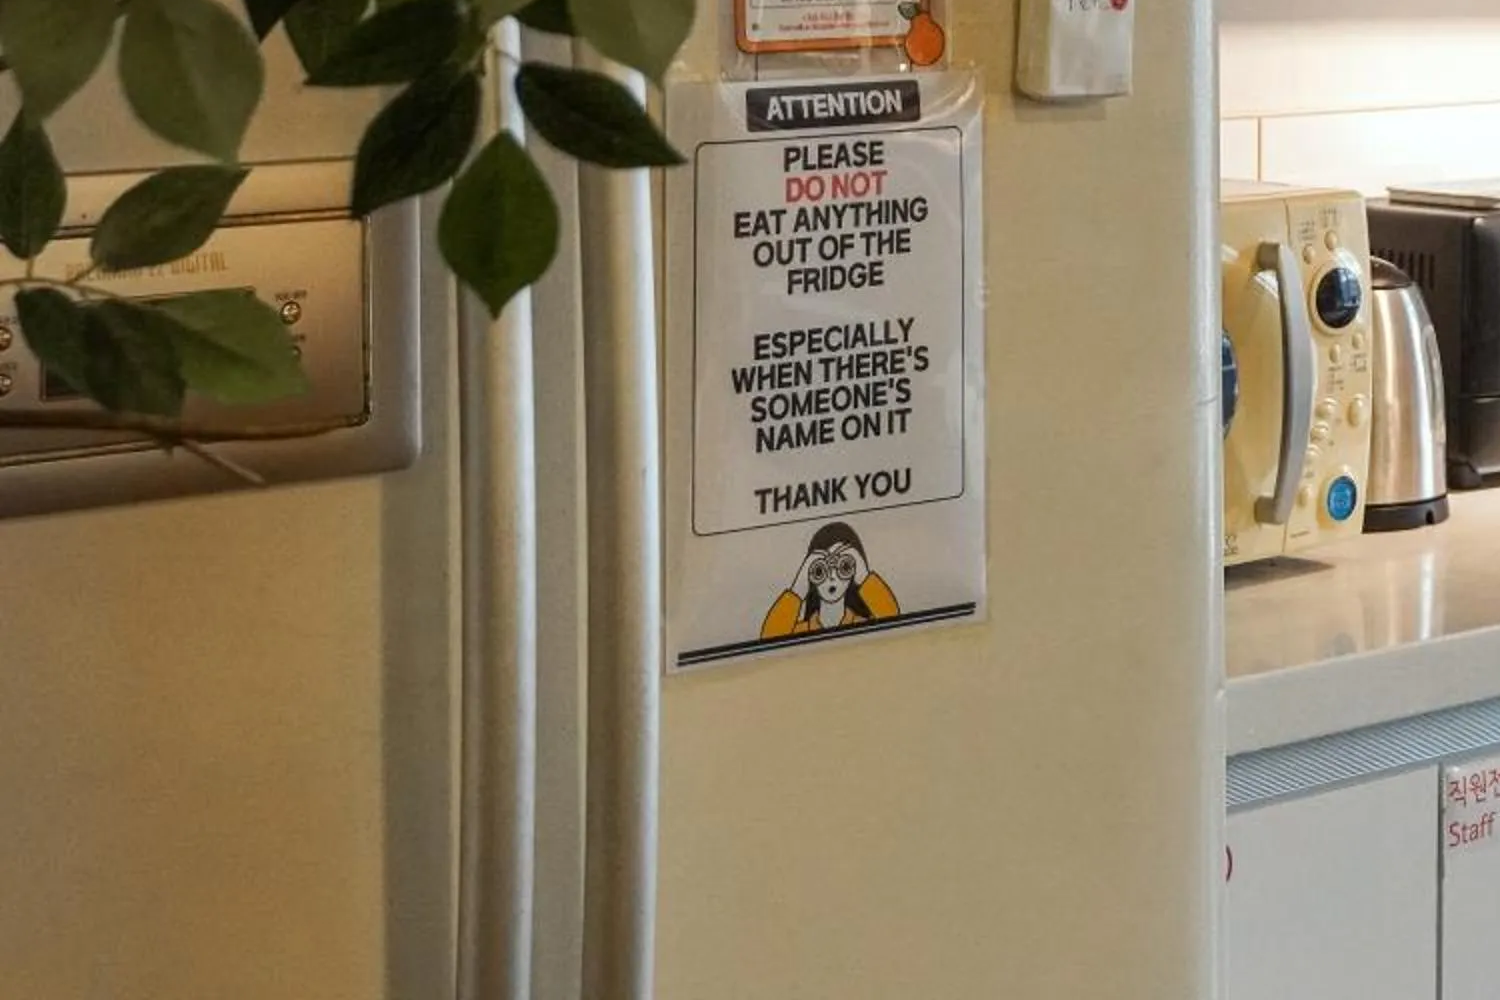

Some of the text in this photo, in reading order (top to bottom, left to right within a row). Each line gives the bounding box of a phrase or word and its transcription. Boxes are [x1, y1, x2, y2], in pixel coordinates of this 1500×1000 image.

[766, 89, 903, 121] ATTENTION
[783, 140, 885, 172] PLEASE
[785, 170, 887, 203] DO NOT
[734, 197, 929, 238] EAT ANYTHING
[753, 228, 911, 267] OUT OF THE
[787, 261, 885, 295] FRIDGE
[753, 317, 915, 361] ESPECIALLY
[731, 345, 929, 394] WHEN THERE'S
[751, 378, 912, 422] SOMEONE'S
[756, 408, 912, 453] NAME ON IT
[755, 468, 912, 514] THANK YOU
[1448, 811, 1496, 848] Staff
